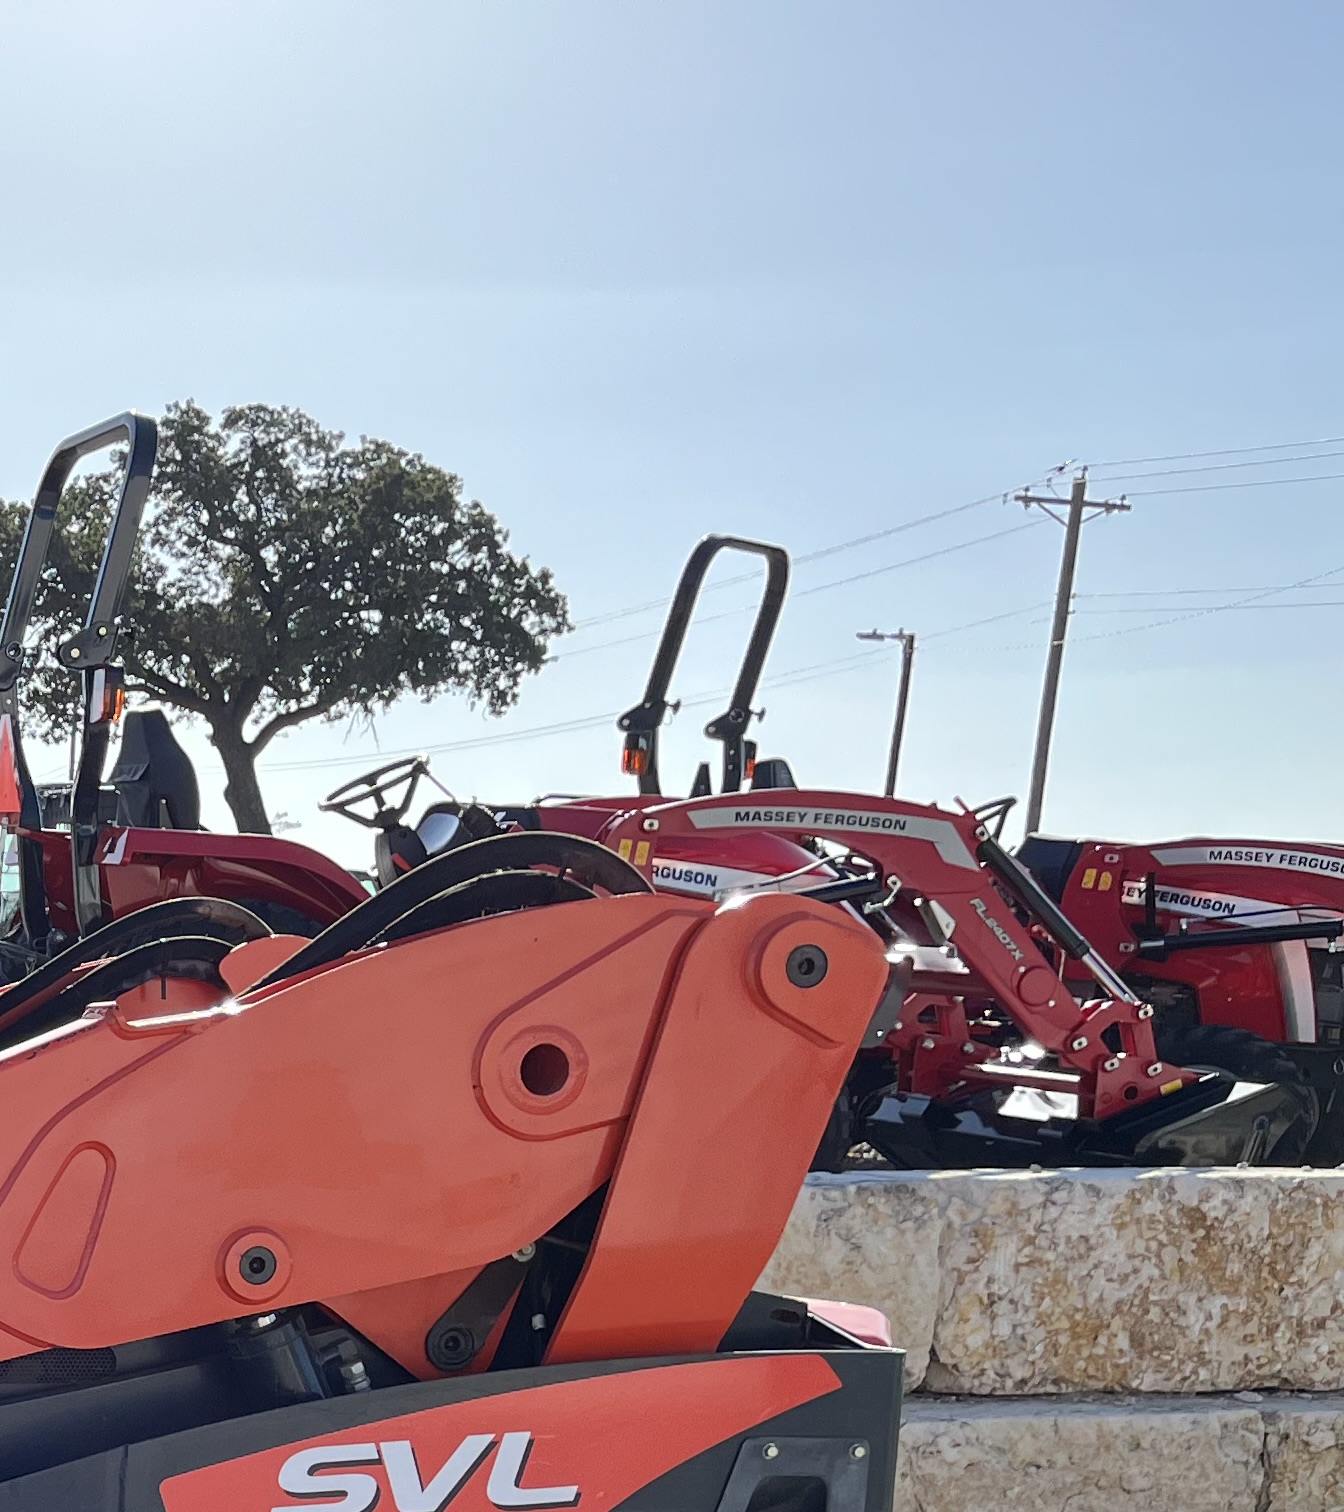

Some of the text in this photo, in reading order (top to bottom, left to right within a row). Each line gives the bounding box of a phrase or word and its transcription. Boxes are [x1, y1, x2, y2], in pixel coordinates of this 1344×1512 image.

[734, 810, 907, 831] MASSEY FERGUSON
[1208, 850, 1274, 863] MASSEY
[652, 865, 717, 887] RGUSON
